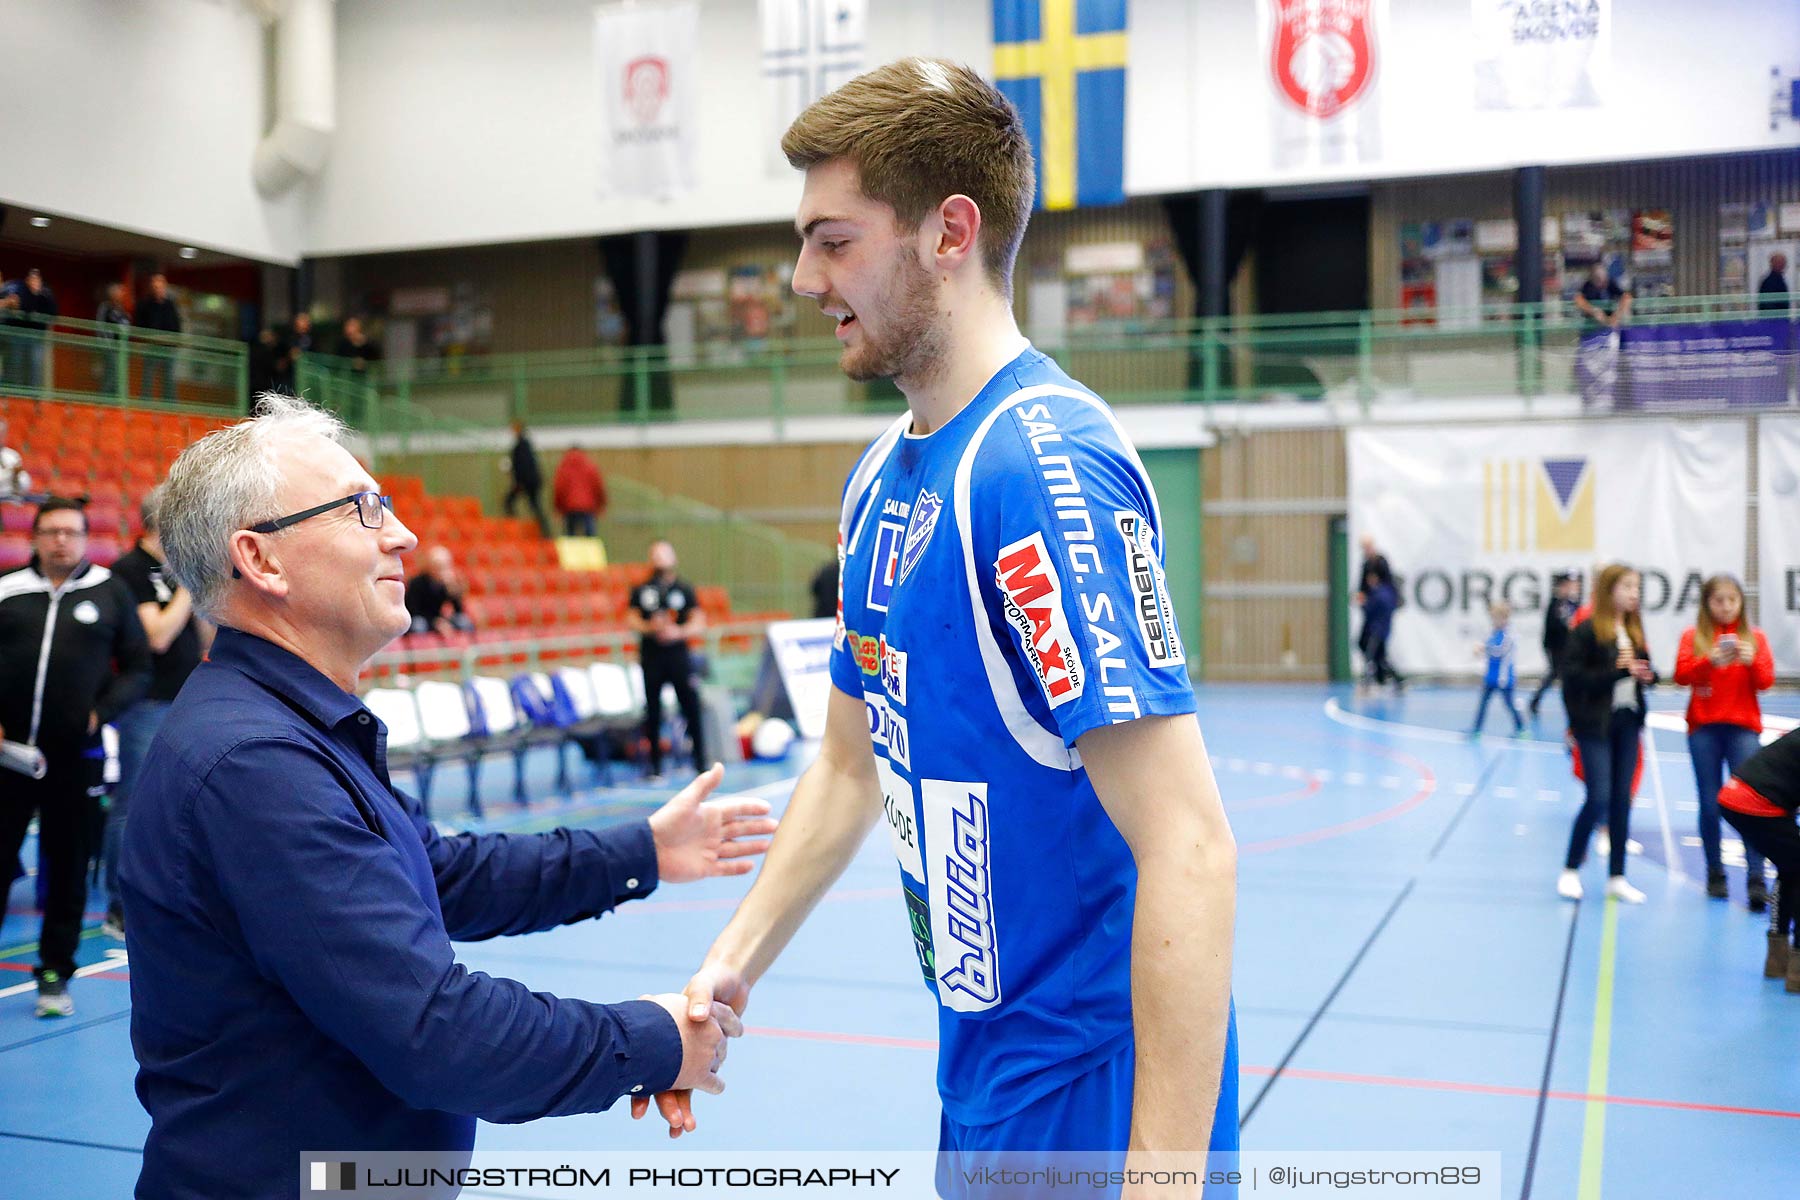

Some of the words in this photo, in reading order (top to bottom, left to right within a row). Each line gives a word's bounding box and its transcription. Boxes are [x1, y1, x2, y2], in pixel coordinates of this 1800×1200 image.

[998, 543, 1072, 698] MAXI
[1063, 646, 1081, 689] SKÖVDE
[939, 792, 999, 1003] bilia
